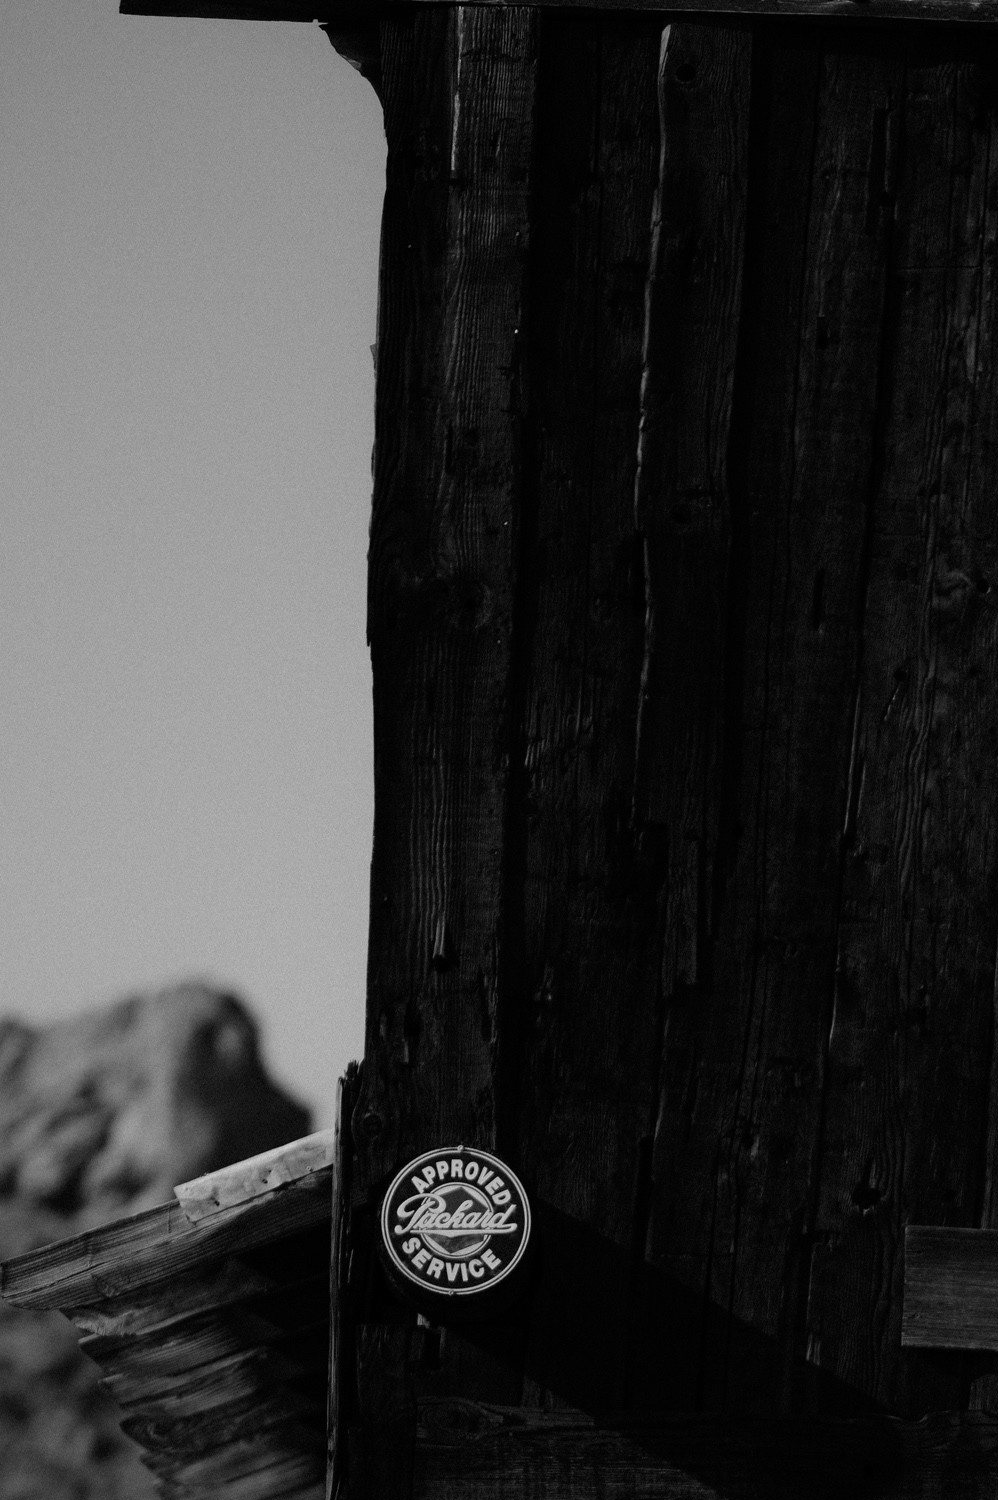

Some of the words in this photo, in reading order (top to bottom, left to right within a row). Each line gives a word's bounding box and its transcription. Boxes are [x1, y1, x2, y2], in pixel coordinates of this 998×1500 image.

[411, 1158, 512, 1206] APPROVED
[394, 1192, 518, 1237] Packard
[401, 1237, 502, 1283] SERVICE
